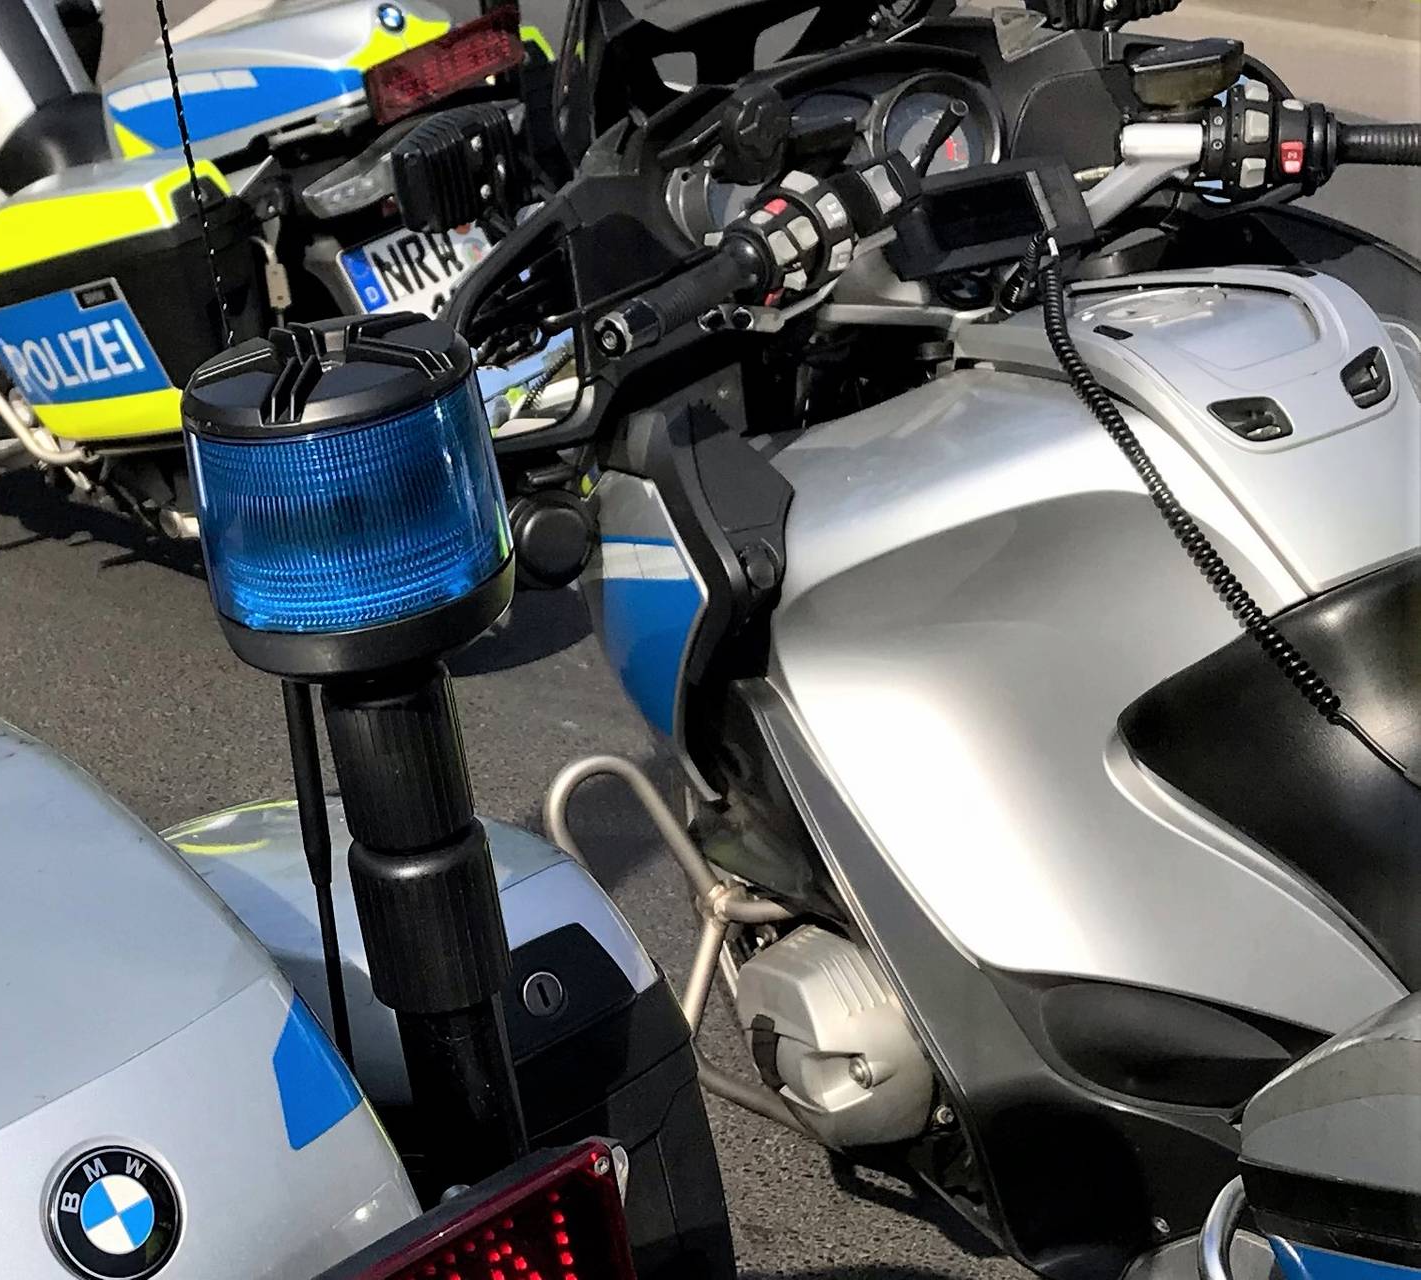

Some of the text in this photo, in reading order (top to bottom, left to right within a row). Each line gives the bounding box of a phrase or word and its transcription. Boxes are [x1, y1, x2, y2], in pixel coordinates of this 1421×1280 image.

[364, 286, 379, 303] D
[371, 232, 464, 302] NRW
[2, 318, 146, 393] POLIZEI
[60, 1156, 147, 1214] BMW
